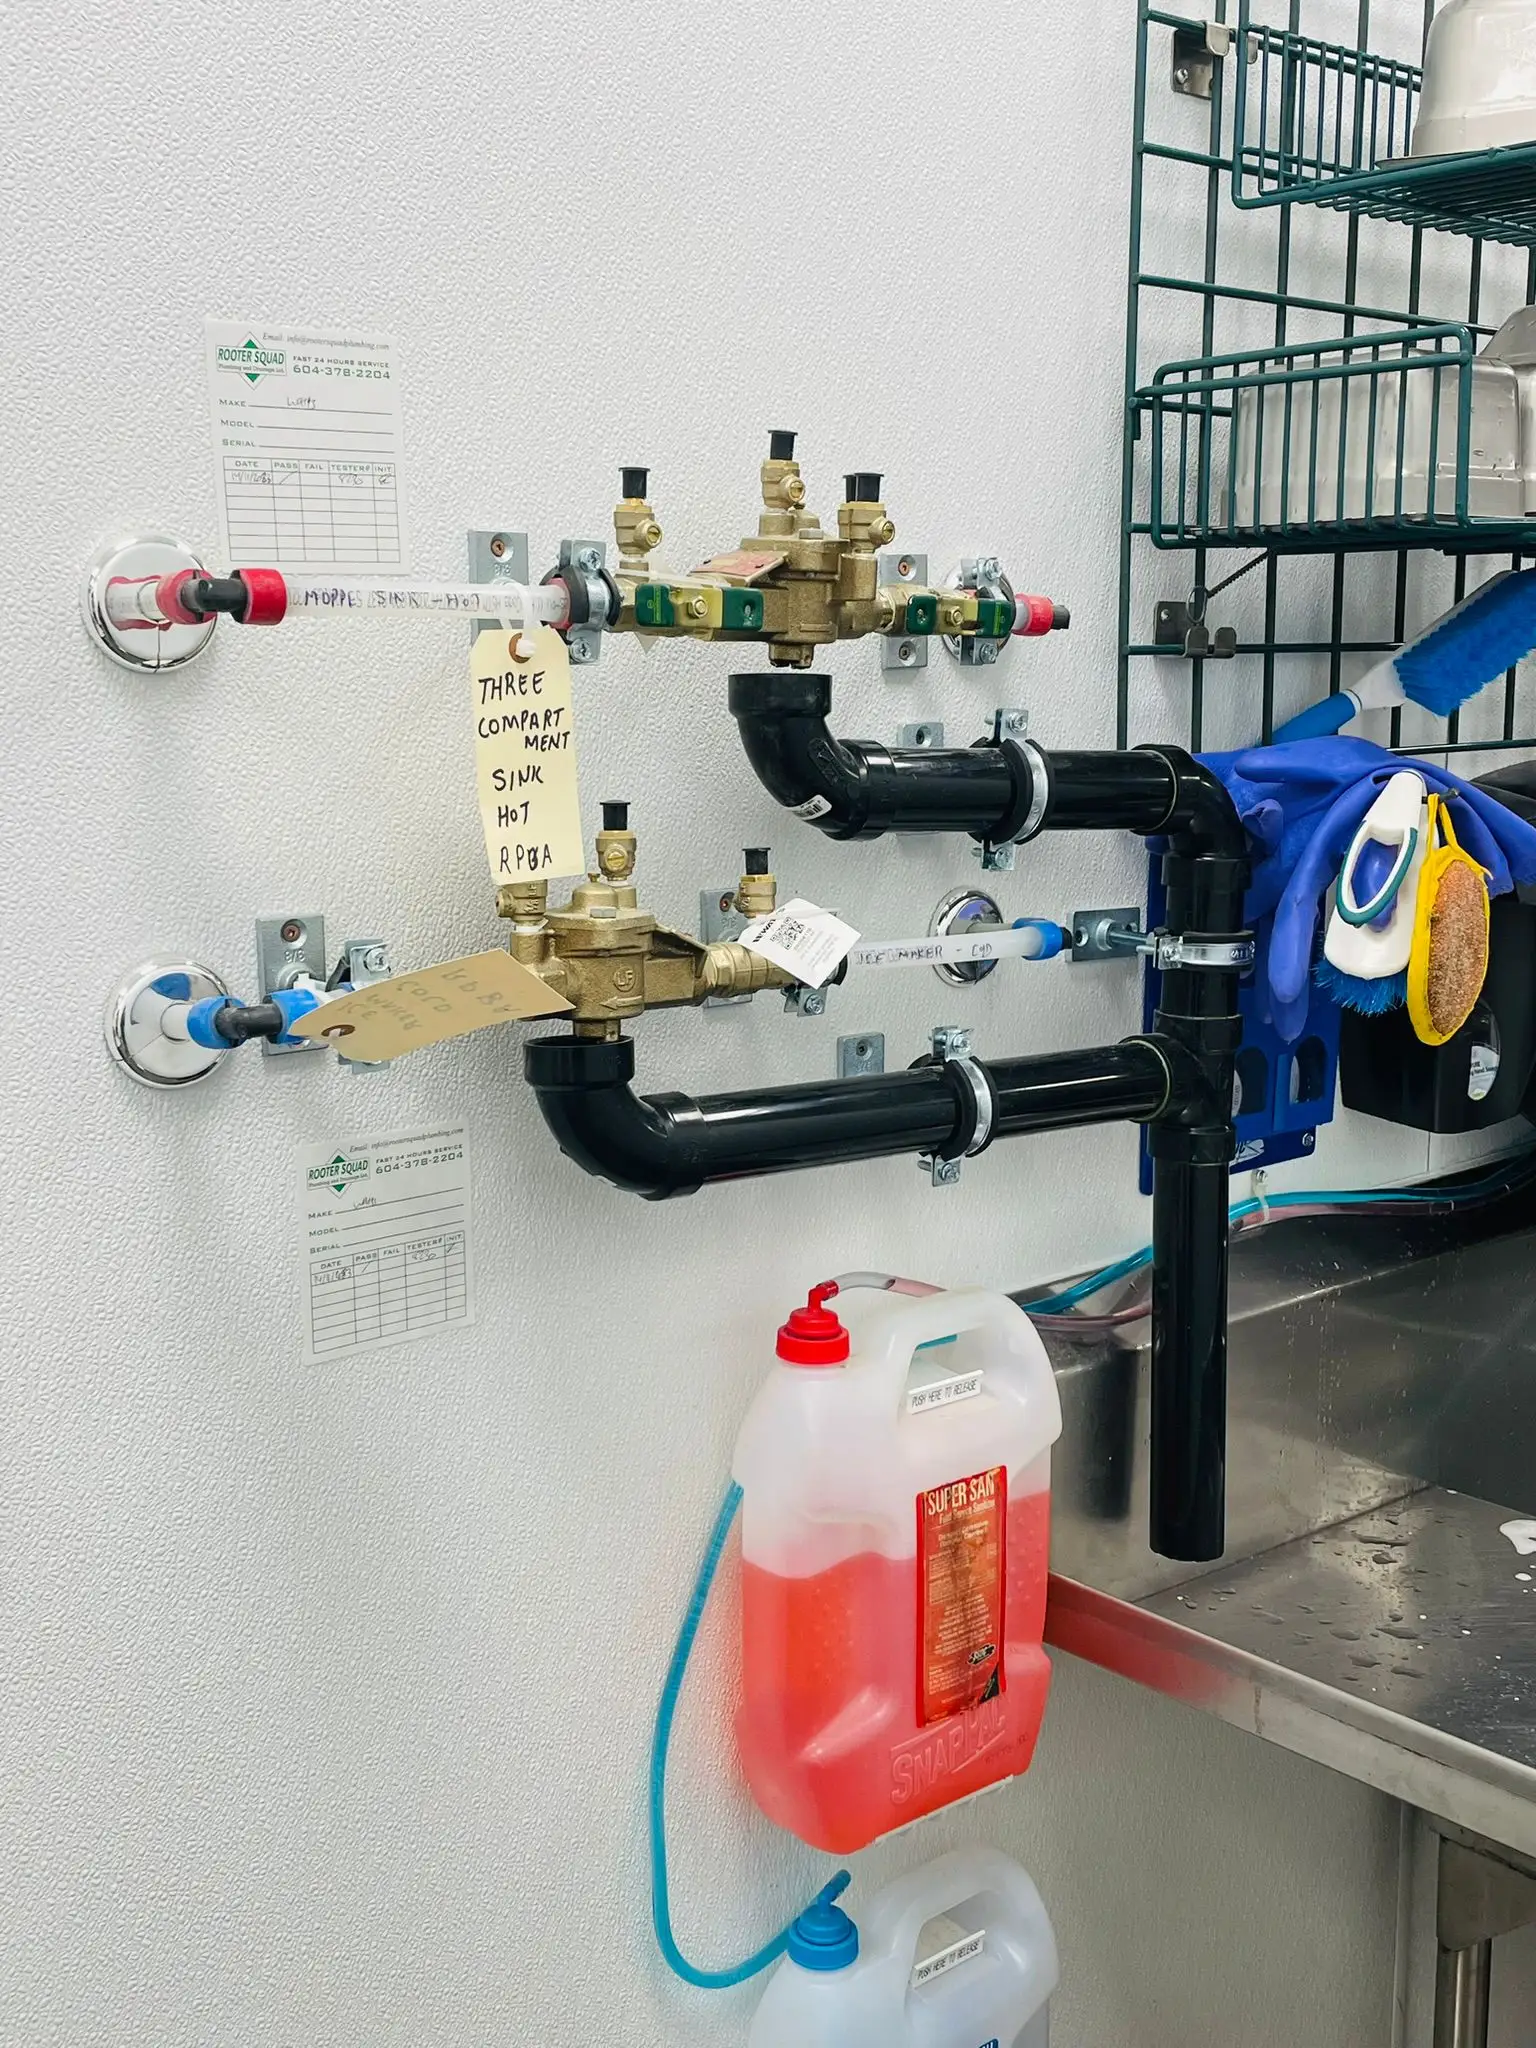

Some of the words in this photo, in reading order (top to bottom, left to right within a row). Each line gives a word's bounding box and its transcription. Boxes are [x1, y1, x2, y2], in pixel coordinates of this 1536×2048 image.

[217, 348, 252, 363] ROOTER
[254, 350, 285, 367] SQUAD
[292, 355, 312, 363] FAST
[327, 358, 354, 366] HOURS
[357, 360, 390, 369] SERVICE
[292, 365, 391, 380] 604-378-2204
[218, 399, 246, 408] MAKE
[220, 419, 255, 429] MODEL
[222, 438, 256, 448] SERIAL
[234, 460, 259, 468] DATE
[273, 462, 298, 470] PASS
[304, 463, 324, 471] FAIL
[478, 671, 546, 705] THREE
[478, 707, 566, 739] COMPART
[524, 731, 571, 752] MENT
[492, 765, 544, 791] SINK
[497, 801, 530, 827] HOT
[375, 1156, 394, 1164] FAST
[406, 1149, 432, 1159] HOURS
[434, 1143, 464, 1155] SERVICE
[375, 1151, 464, 1175] 604-378-2204
[308, 1163, 340, 1180] ROOTER
[341, 1159, 369, 1175] SQUAD
[308, 1210, 334, 1220] MAKE
[308, 1227, 340, 1237] MODEL
[309, 1243, 341, 1254] SERIAL
[320, 1260, 343, 1270] DATE
[355, 1252, 377, 1262] PASS
[383, 1247, 400, 1256] FAIL
[928, 1481, 968, 1516] SUPER
[969, 1471, 996, 1502] SAN
